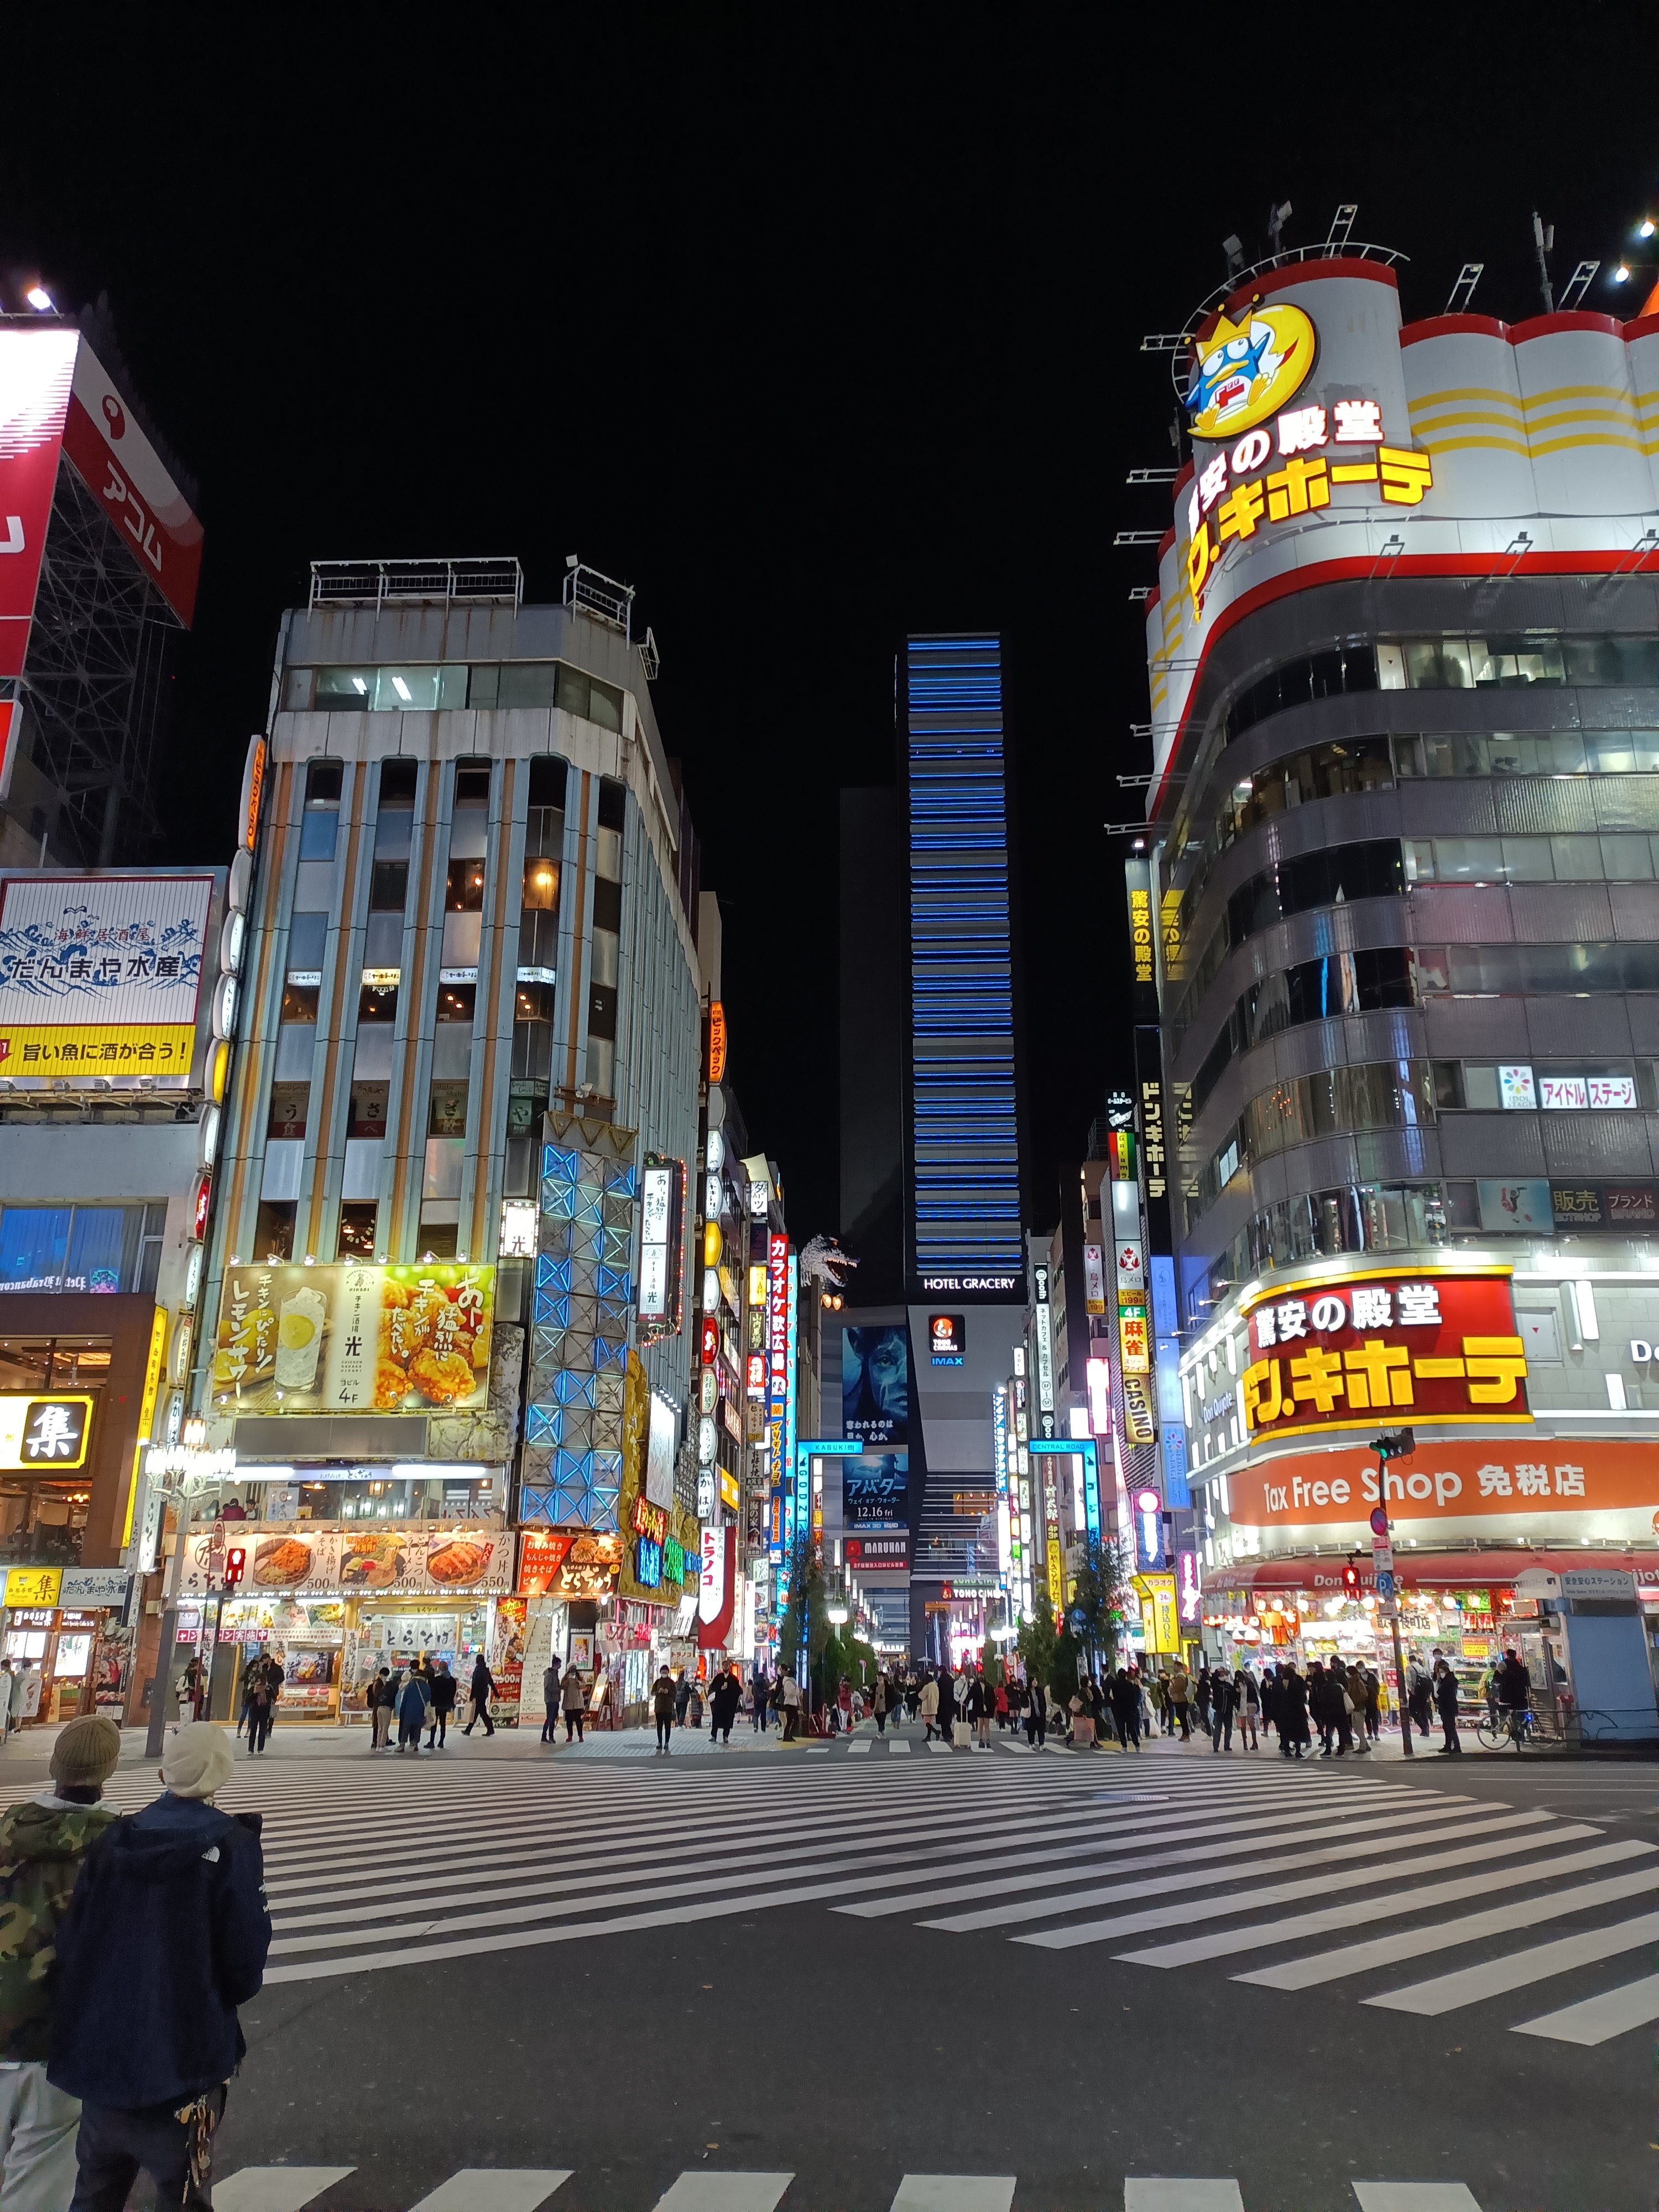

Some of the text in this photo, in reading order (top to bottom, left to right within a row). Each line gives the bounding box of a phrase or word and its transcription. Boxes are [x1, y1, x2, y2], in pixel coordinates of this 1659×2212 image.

[103, 459, 162, 572] アコム
[54, 928, 150, 942] 海鮮居酒屋
[1130, 890, 1152, 982] 驚安の殿堂
[12, 956, 181, 979] だんまや水産
[1543, 1082, 1632, 1106] アイドル ステージ
[285, 1104, 297, 1120] う
[367, 1103, 380, 1118] さ
[754, 1183, 763, 1209] ダーツ
[1553, 1190, 1599, 1211] 販売
[1608, 1194, 1653, 1208] ブランド
[925, 1279, 1015, 1290] HOTEL GRACERY
[1090, 1273, 1099, 1297] 鳥メロ
[414, 1279, 435, 1335] チキンが
[648, 1292, 657, 1303] 光
[352, 1296, 361, 1333] チキン酒場
[1124, 1307, 1141, 1317] 4F
[1255, 1285, 1443, 1348] 驚安の殿堂
[228, 1280, 249, 1400] レモンサワー
[391, 1306, 409, 1358] たべたい。
[436, 1305, 460, 1361] 猛烈に
[1124, 1321, 1144, 1356] 麻雀
[345, 1336, 362, 1357] 光
[341, 1378, 359, 1386] 当ビル
[339, 1387, 358, 1404] 4F
[1125, 1379, 1152, 1438] CASINO
[1203, 1391, 1233, 1424] Don Quijote
[25, 1405, 79, 1458] 集
[846, 1420, 894, 1430] 奪われるのは
[771, 1421, 782, 1487] マツモトキヨシ
[847, 1478, 906, 1496] アバター
[1292, 1476, 1351, 1509] Free
[1361, 1467, 1463, 1507] Shop
[1478, 1464, 1586, 1498] 免税店
[1045, 1485, 1058, 1521] 甘太郎
[1172, 1490, 1183, 1499] 5F
[1264, 1483, 1289, 1513] Tax
[749, 1501, 758, 1526] 海の家
[857, 1507, 883, 1517] 12.16
[317, 1537, 325, 1556] そば
[326, 1537, 337, 1574] かき揚げ
[404, 1537, 413, 1575] ラーメン
[415, 1537, 426, 1575] とんこつ
[497, 1534, 511, 1573] かつ丼
[526, 1553, 562, 1562] もんじゃ焼き
[527, 1541, 563, 1551] お好み焼き
[865, 1542, 906, 1553] MARUHAN
[524, 1565, 552, 1574] 焼きそば
[702, 1532, 714, 1586] トラノコ
[33, 1574, 56, 1601] 集
[307, 1578, 336, 1590] 500円
[394, 1576, 422, 1589] 500円
[481, 1576, 509, 1588] 550円
[523, 1577, 538, 1586] ピザ
[560, 1565, 612, 1589] とらぢゅう
[1314, 1575, 1342, 1587] Don
[1379, 1579, 1386, 1594] P
[1565, 1577, 1629, 1585] 安全安心ステーション
[66, 1584, 127, 1594] だんまや水産
[953, 1589, 977, 1598] TOHO
[388, 1629, 453, 1646] とらそば
